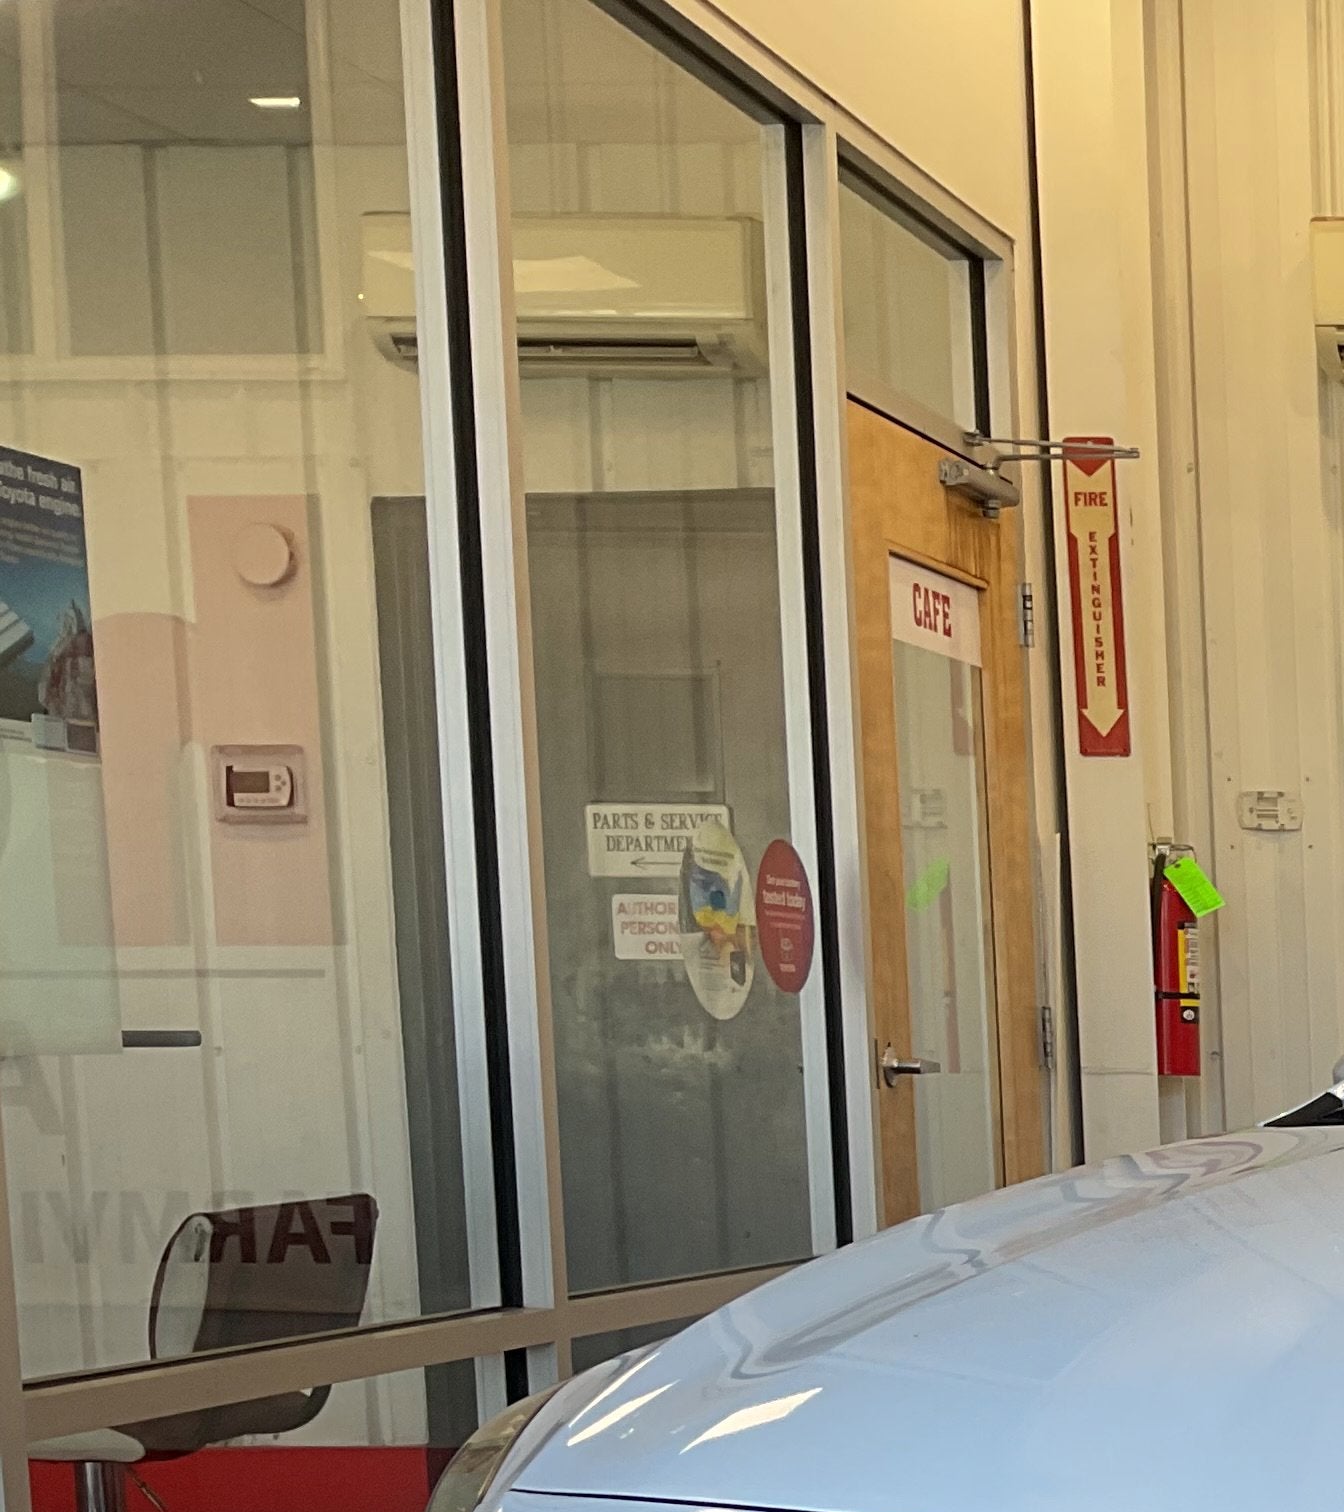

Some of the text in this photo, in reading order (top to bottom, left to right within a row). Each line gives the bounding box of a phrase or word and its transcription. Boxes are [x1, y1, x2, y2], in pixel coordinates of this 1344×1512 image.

[1074, 491, 1108, 507] FIRE
[912, 582, 952, 639] CAFE
[1088, 531, 1106, 687] EXTINGUISHER
[592, 812, 639, 830] PARTS
[645, 812, 655, 830] &
